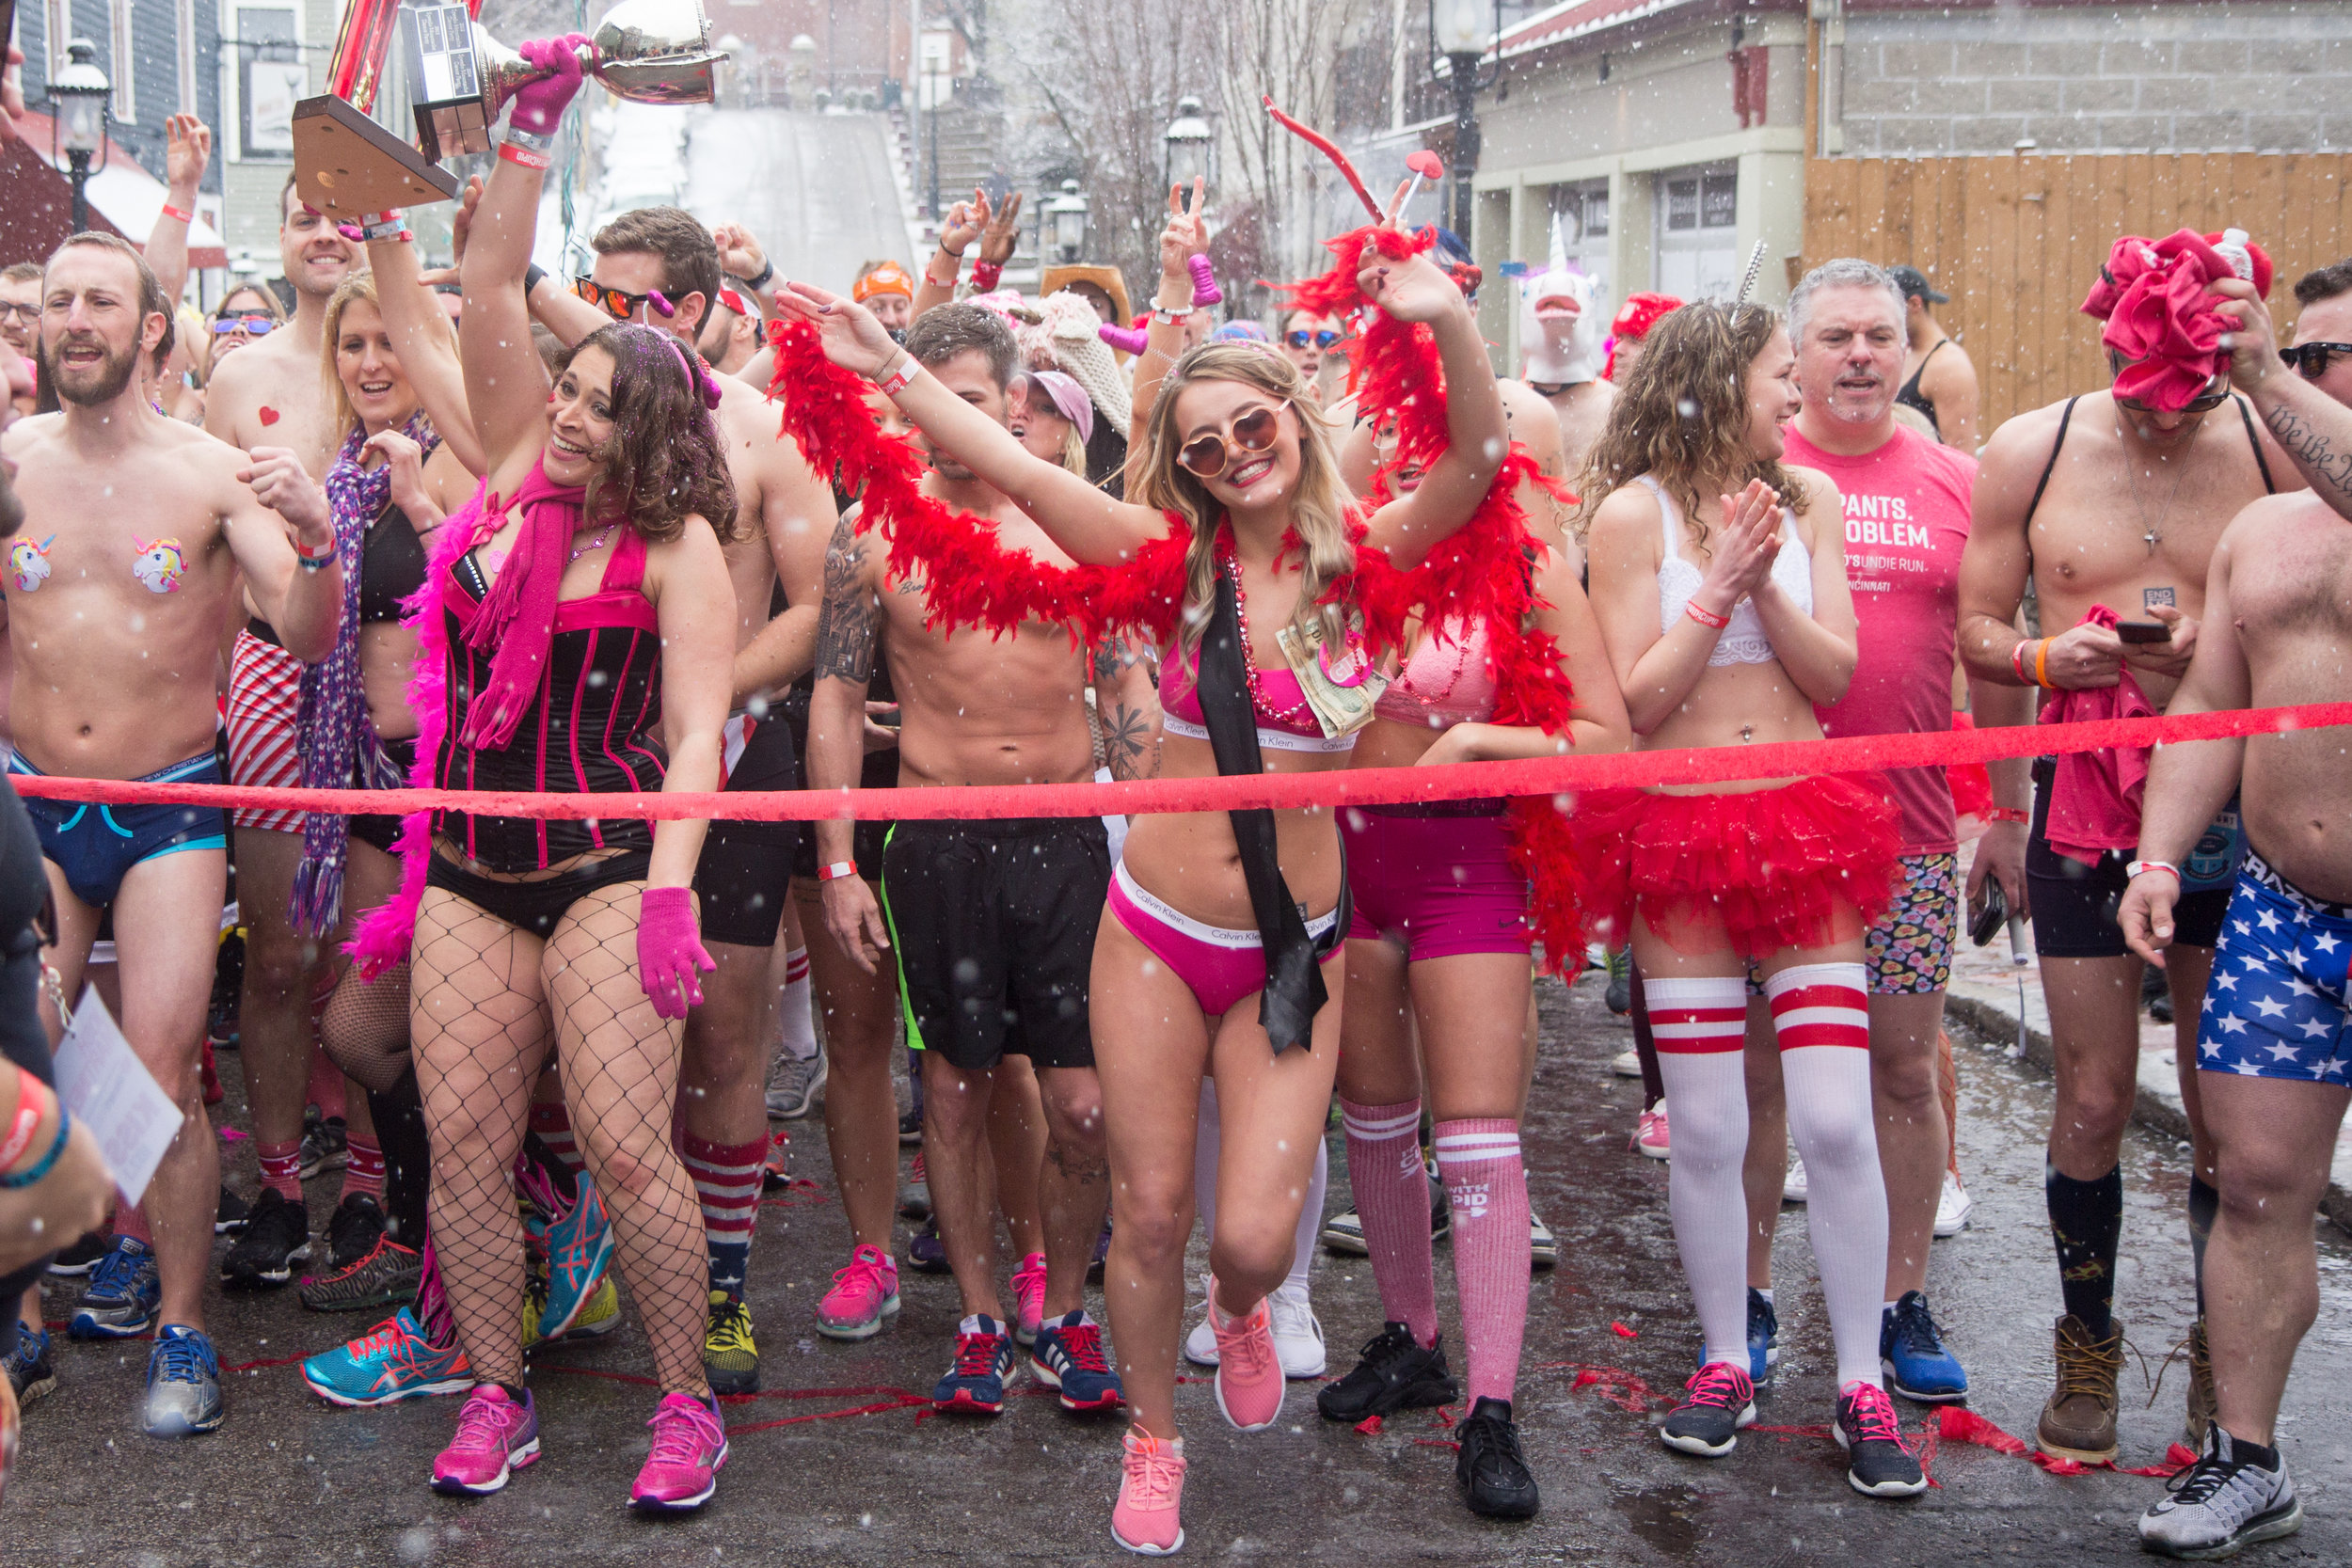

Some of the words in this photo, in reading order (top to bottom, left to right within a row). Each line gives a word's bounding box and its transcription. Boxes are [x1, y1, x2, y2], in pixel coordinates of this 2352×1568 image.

[1845, 519, 1936, 550] OBLEM.
[1861, 554, 1897, 570] UNDIE
[1848, 578, 1891, 593] NCINNATI
[2147, 590, 2171, 599] END
[1184, 723, 1205, 736] Klein
[1267, 736, 1294, 748] Klein
[1321, 740, 1344, 751] Calvin
[1136, 888, 1162, 912] Calvin
[1162, 907, 1184, 926] Klein
[1307, 920, 1327, 932] alvin
[1211, 928, 1244, 941] Calvin
[1245, 931, 1262, 942] Kle
[1452, 1193, 1487, 1207] PID
